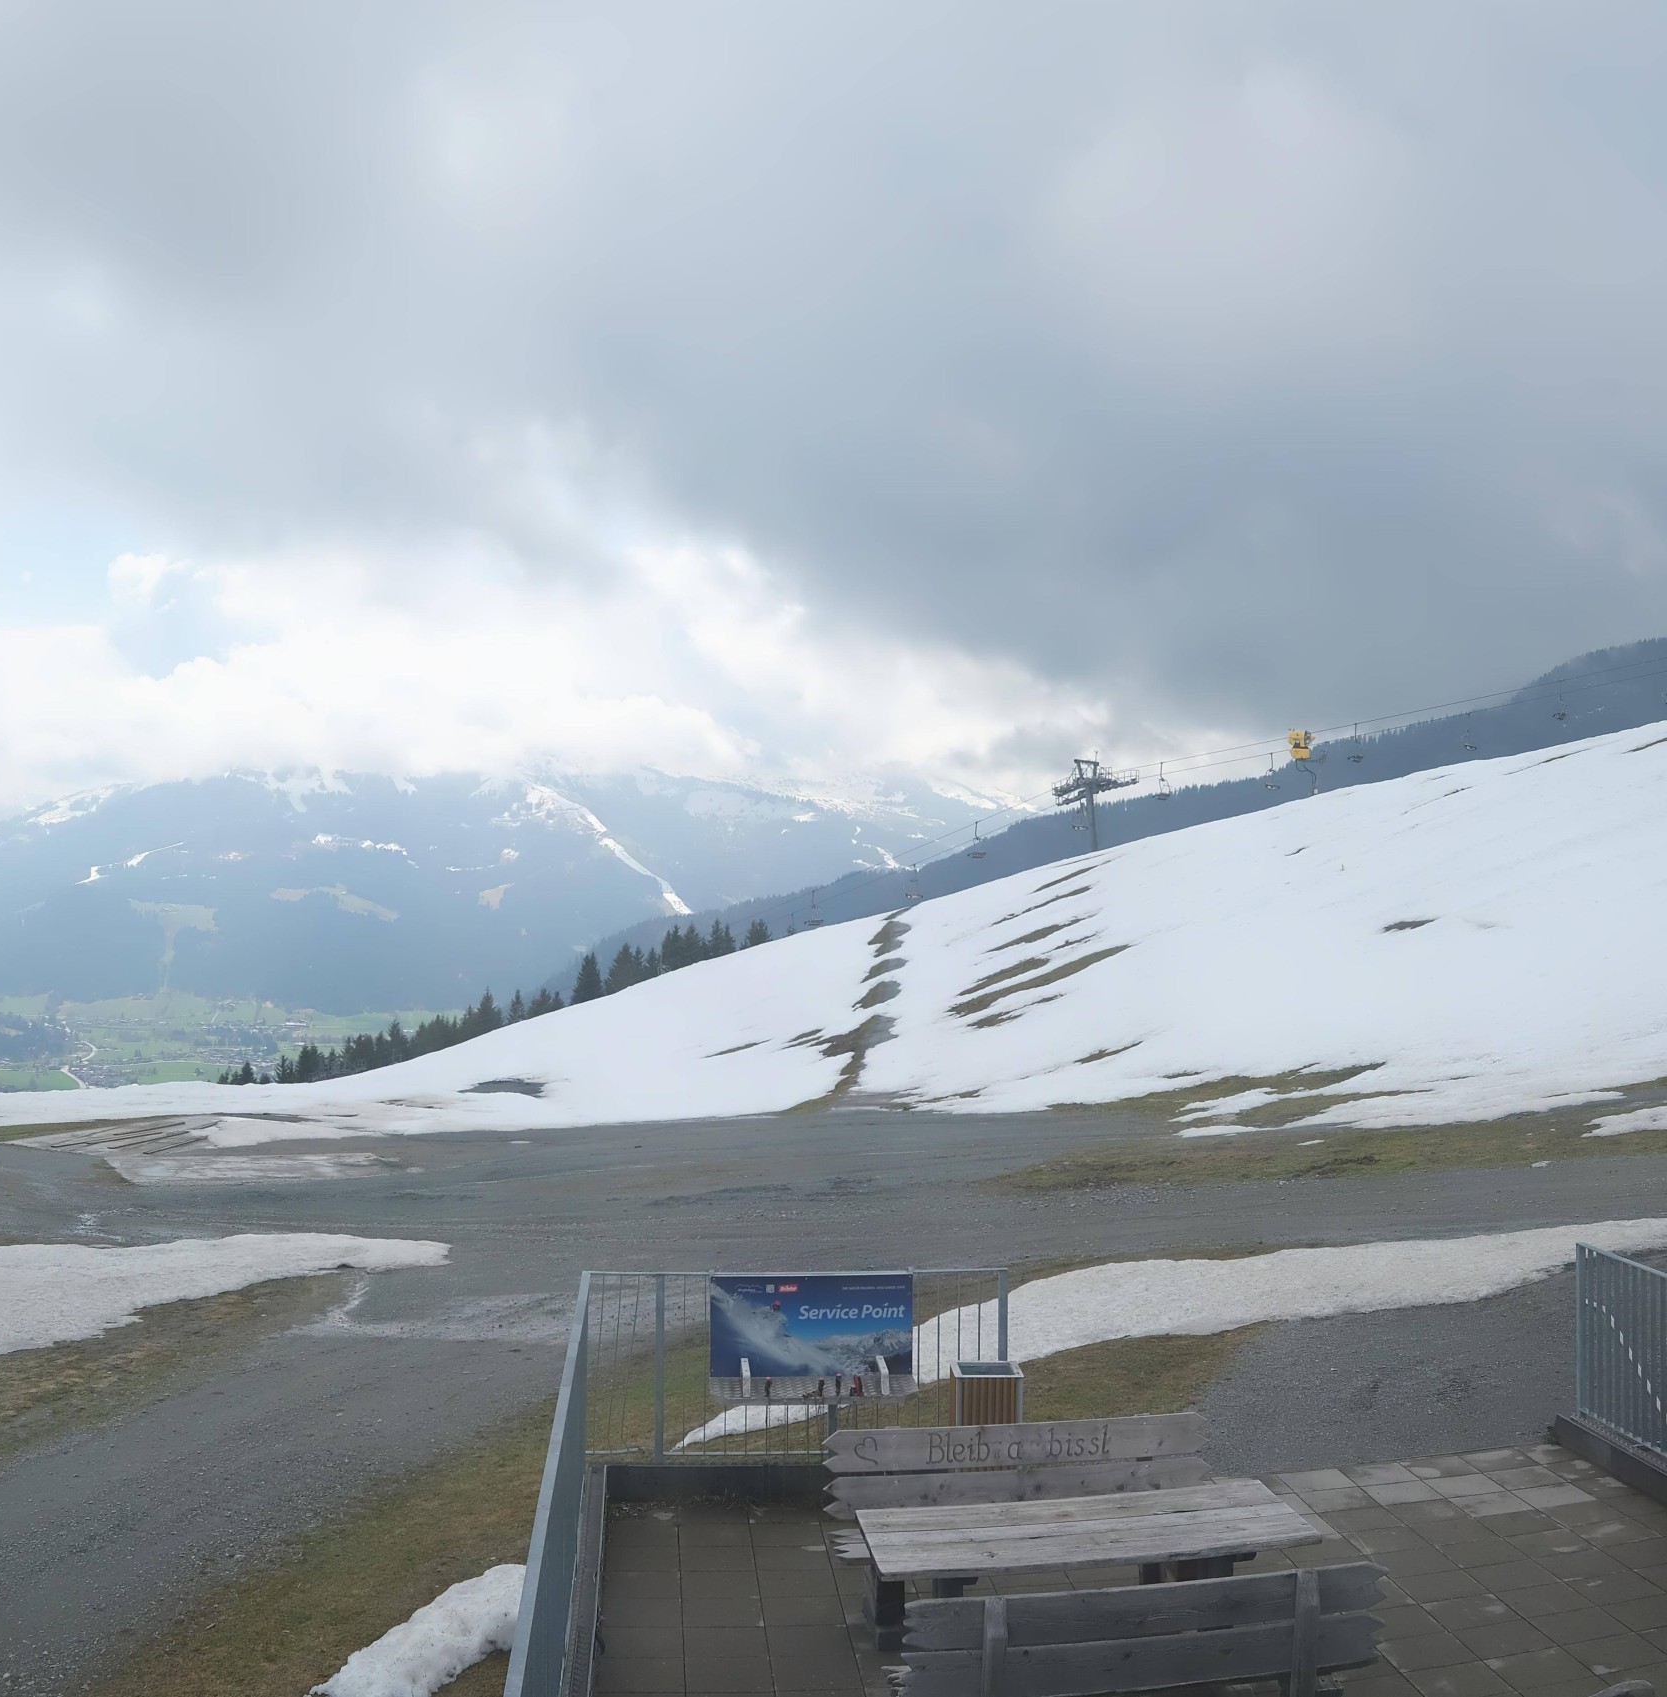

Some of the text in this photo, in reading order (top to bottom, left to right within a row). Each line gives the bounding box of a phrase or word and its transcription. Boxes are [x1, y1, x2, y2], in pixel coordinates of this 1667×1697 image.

[798, 1302, 906, 1320] Service Point
[925, 1430, 990, 1465] Bleib
[1046, 1423, 1110, 1458] bissl
